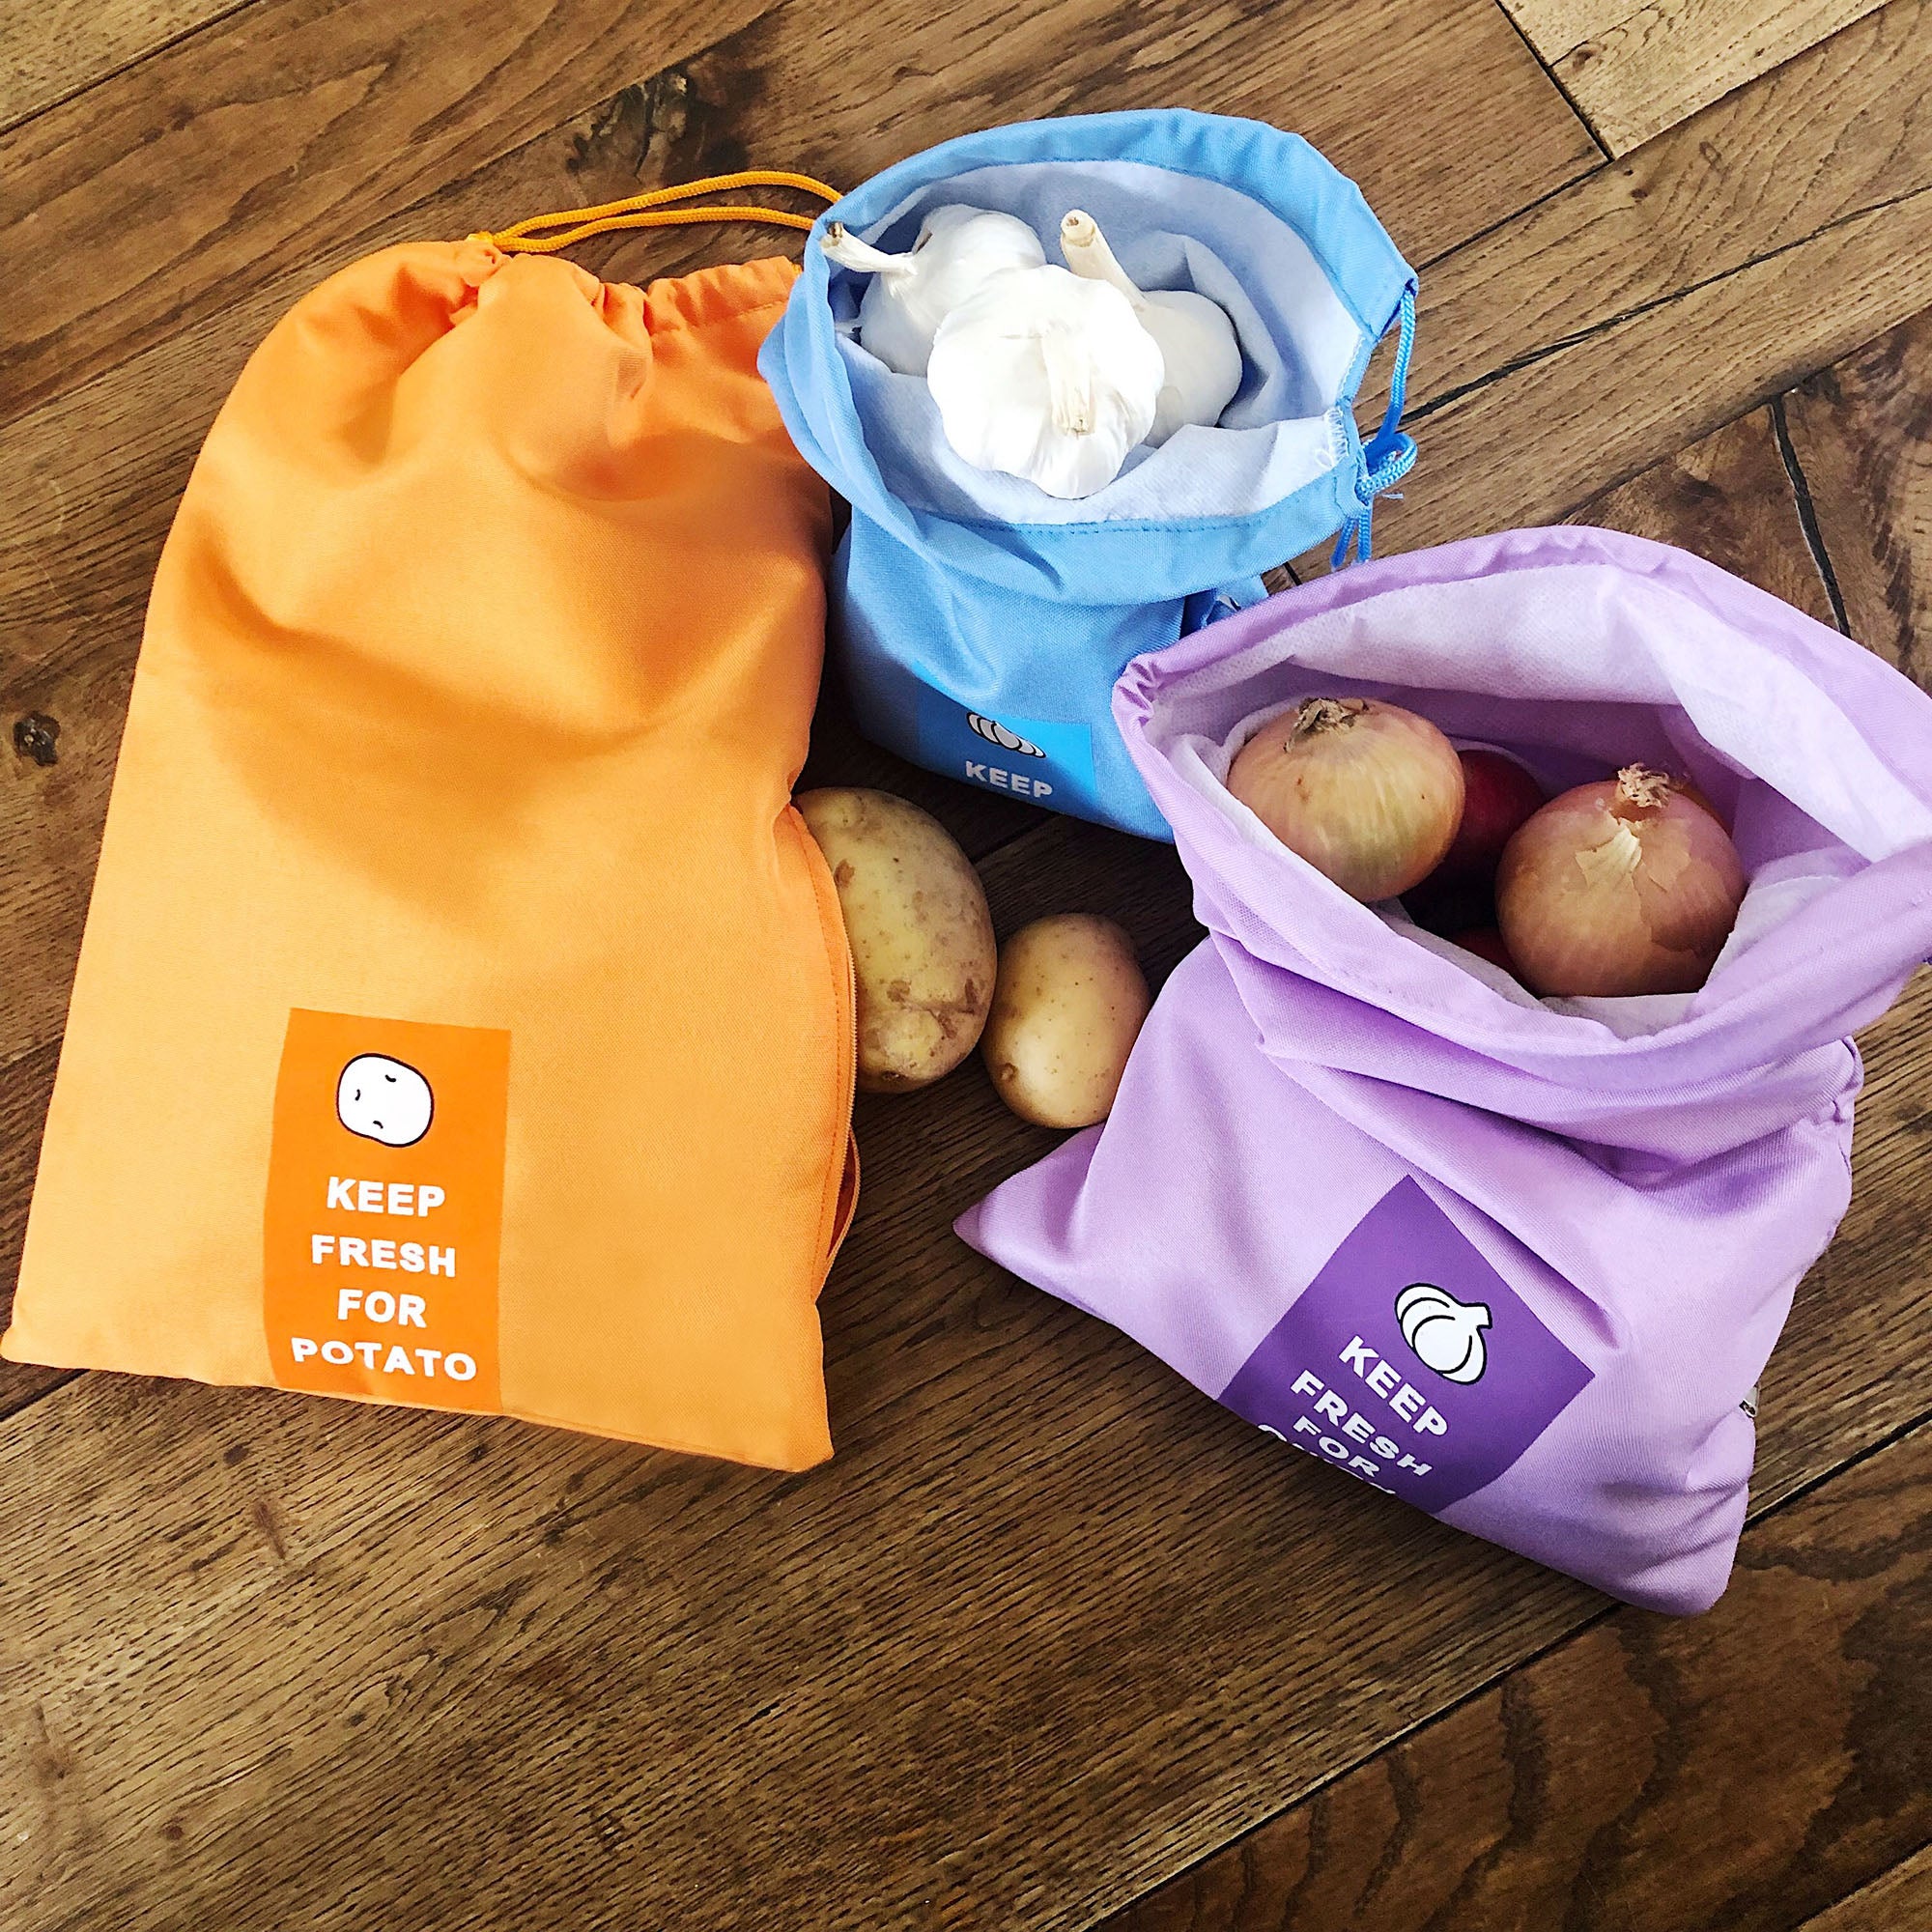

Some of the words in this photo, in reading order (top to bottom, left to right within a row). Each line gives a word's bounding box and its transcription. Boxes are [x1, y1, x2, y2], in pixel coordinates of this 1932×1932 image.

[965, 760, 1053, 798] KEEP
[327, 1176, 445, 1217] KEEP
[311, 1234, 456, 1278] FRESH
[337, 1288, 427, 1328] FOR
[291, 1337, 477, 1381] POTATO
[1338, 1335, 1448, 1437] KEEP
[1290, 1369, 1434, 1477] FRESH
[1293, 1415, 1381, 1479] FOR
